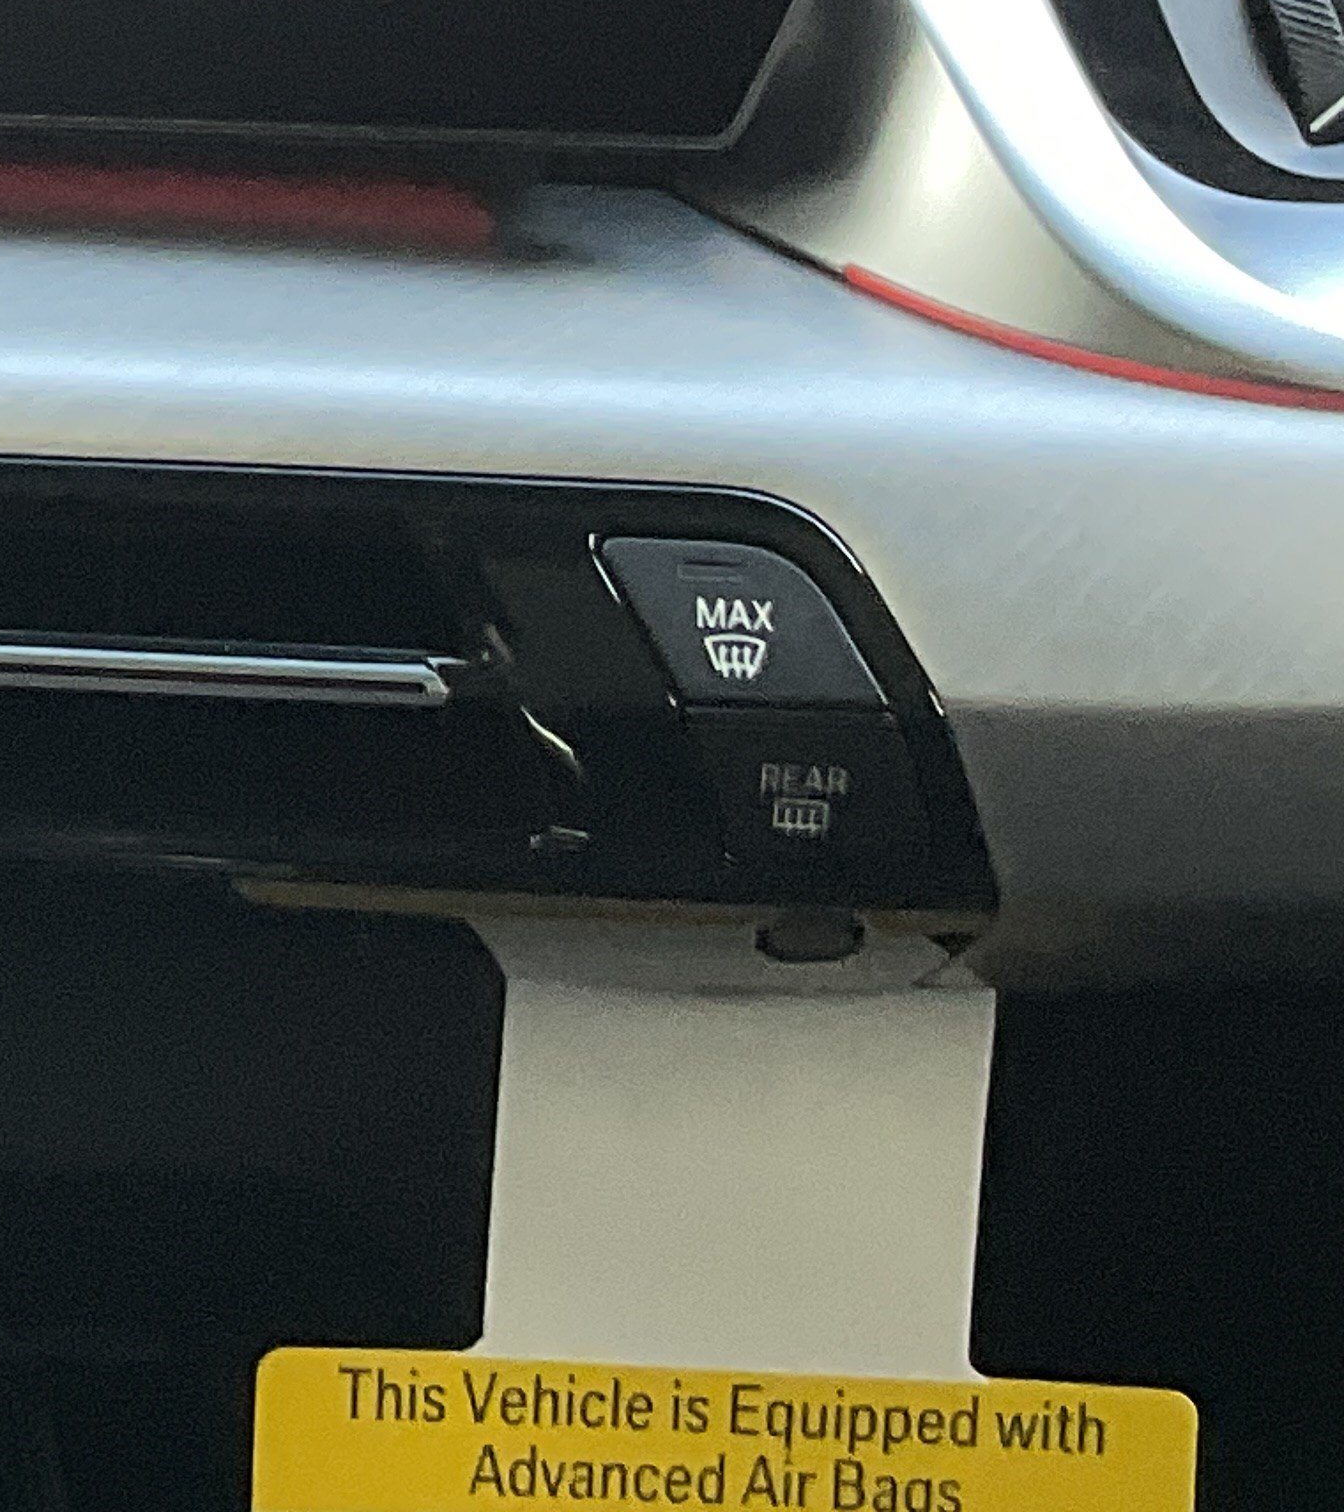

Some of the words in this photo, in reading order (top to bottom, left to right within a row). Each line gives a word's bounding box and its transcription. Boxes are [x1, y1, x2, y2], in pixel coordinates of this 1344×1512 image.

[696, 596, 775, 633] MAX
[760, 763, 850, 797] REAR
[338, 1366, 446, 1423] This
[463, 1370, 654, 1432] Vehicle
[671, 1378, 710, 1434] is
[727, 1384, 980, 1456] Equipped
[995, 1400, 1108, 1458] with
[469, 1444, 726, 1505] Advanced
[741, 1454, 818, 1508] Air
